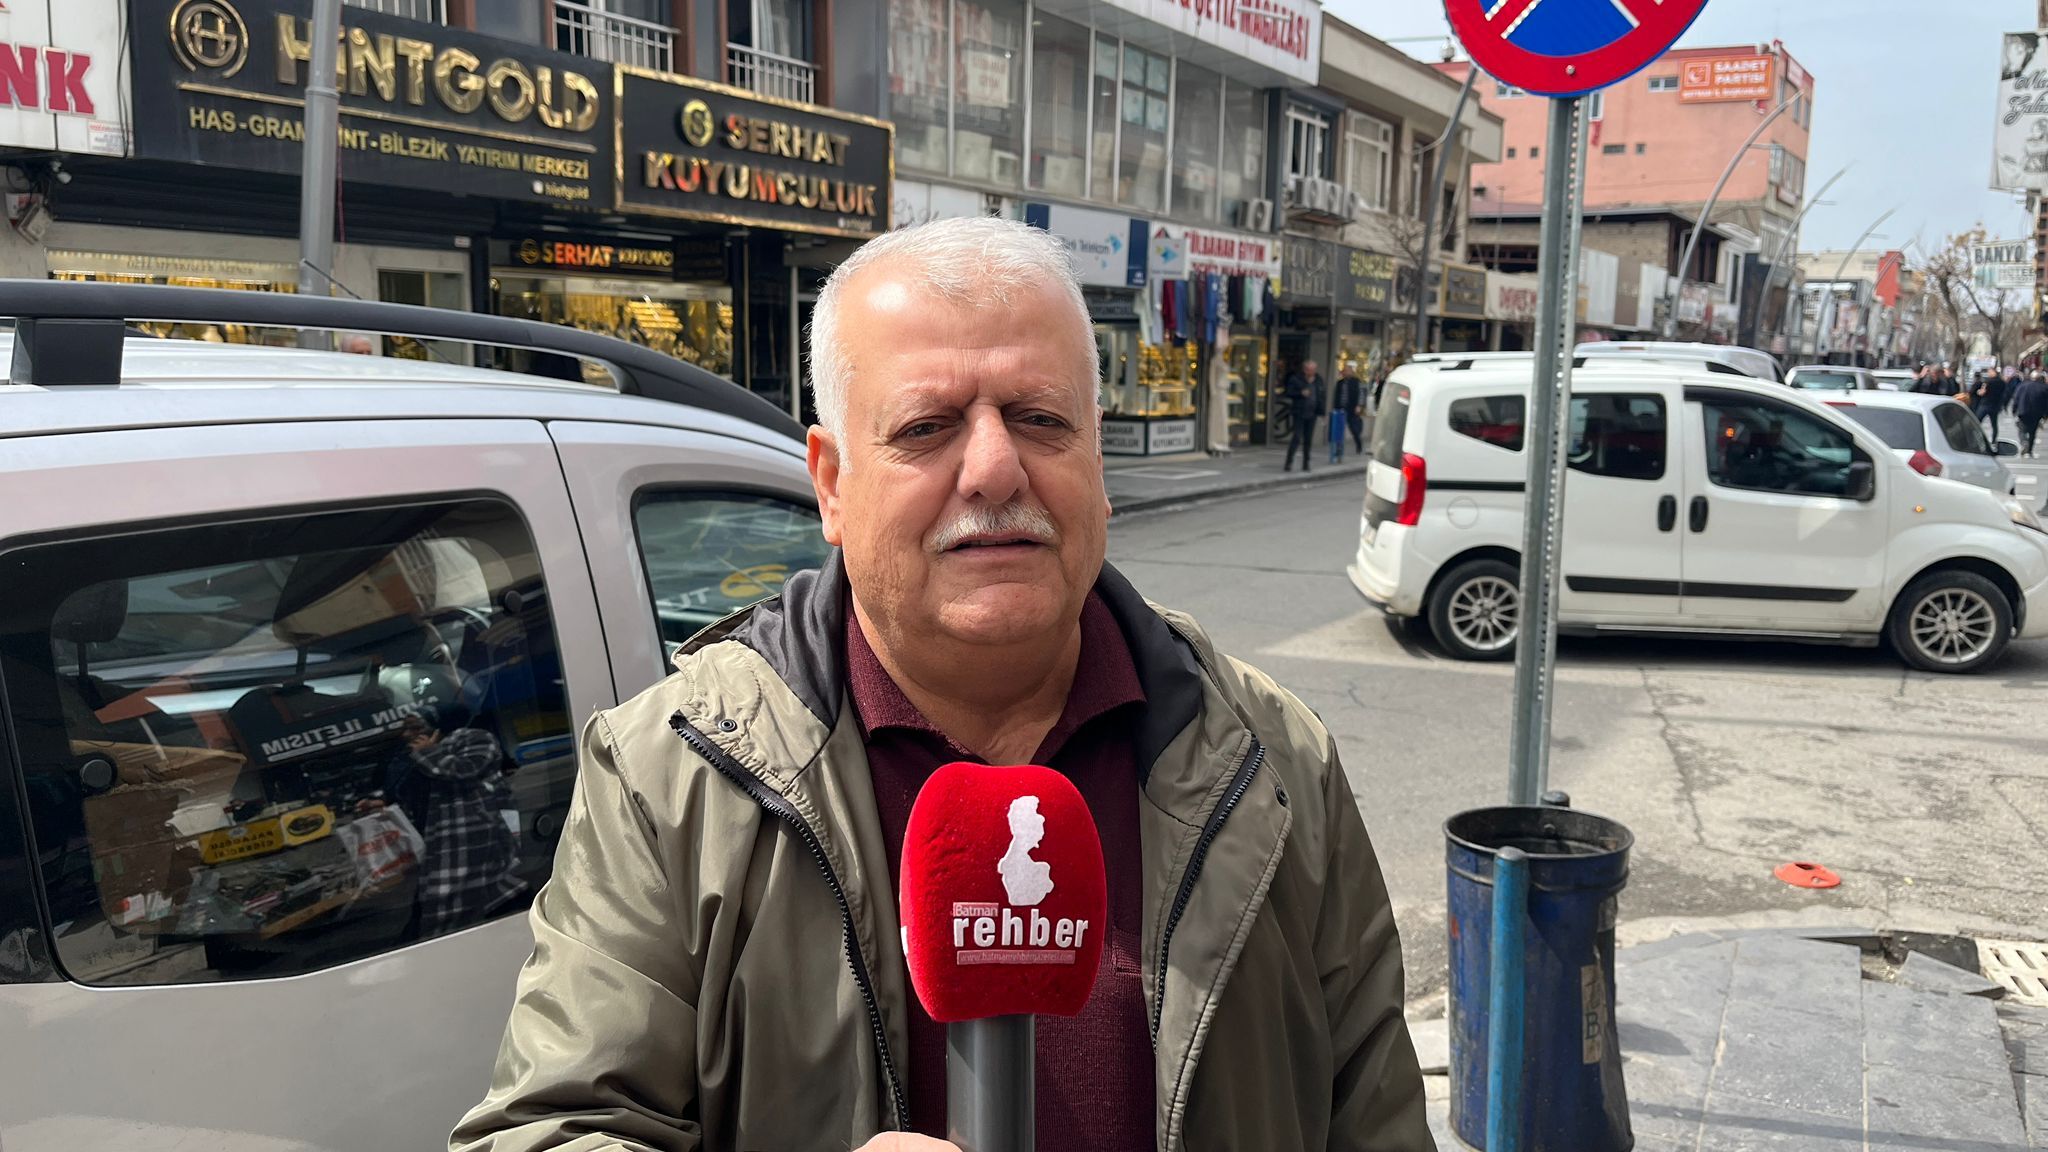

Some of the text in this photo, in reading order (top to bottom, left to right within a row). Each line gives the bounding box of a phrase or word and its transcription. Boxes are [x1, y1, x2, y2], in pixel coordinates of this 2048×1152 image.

[0, 42, 95, 116] NK
[275, 11, 600, 132] HİNTGOLD
[723, 113, 850, 167] SERHAT
[455, 143, 521, 171] YATIRIM
[523, 152, 590, 180] MERKEZİ
[644, 150, 878, 217] KUYUMCULUK
[542, 240, 614, 268] SERHAT
[1975, 245, 2024, 265] BANYO
[953, 908, 1089, 948] rehber
[955, 904, 998, 917] Batman
